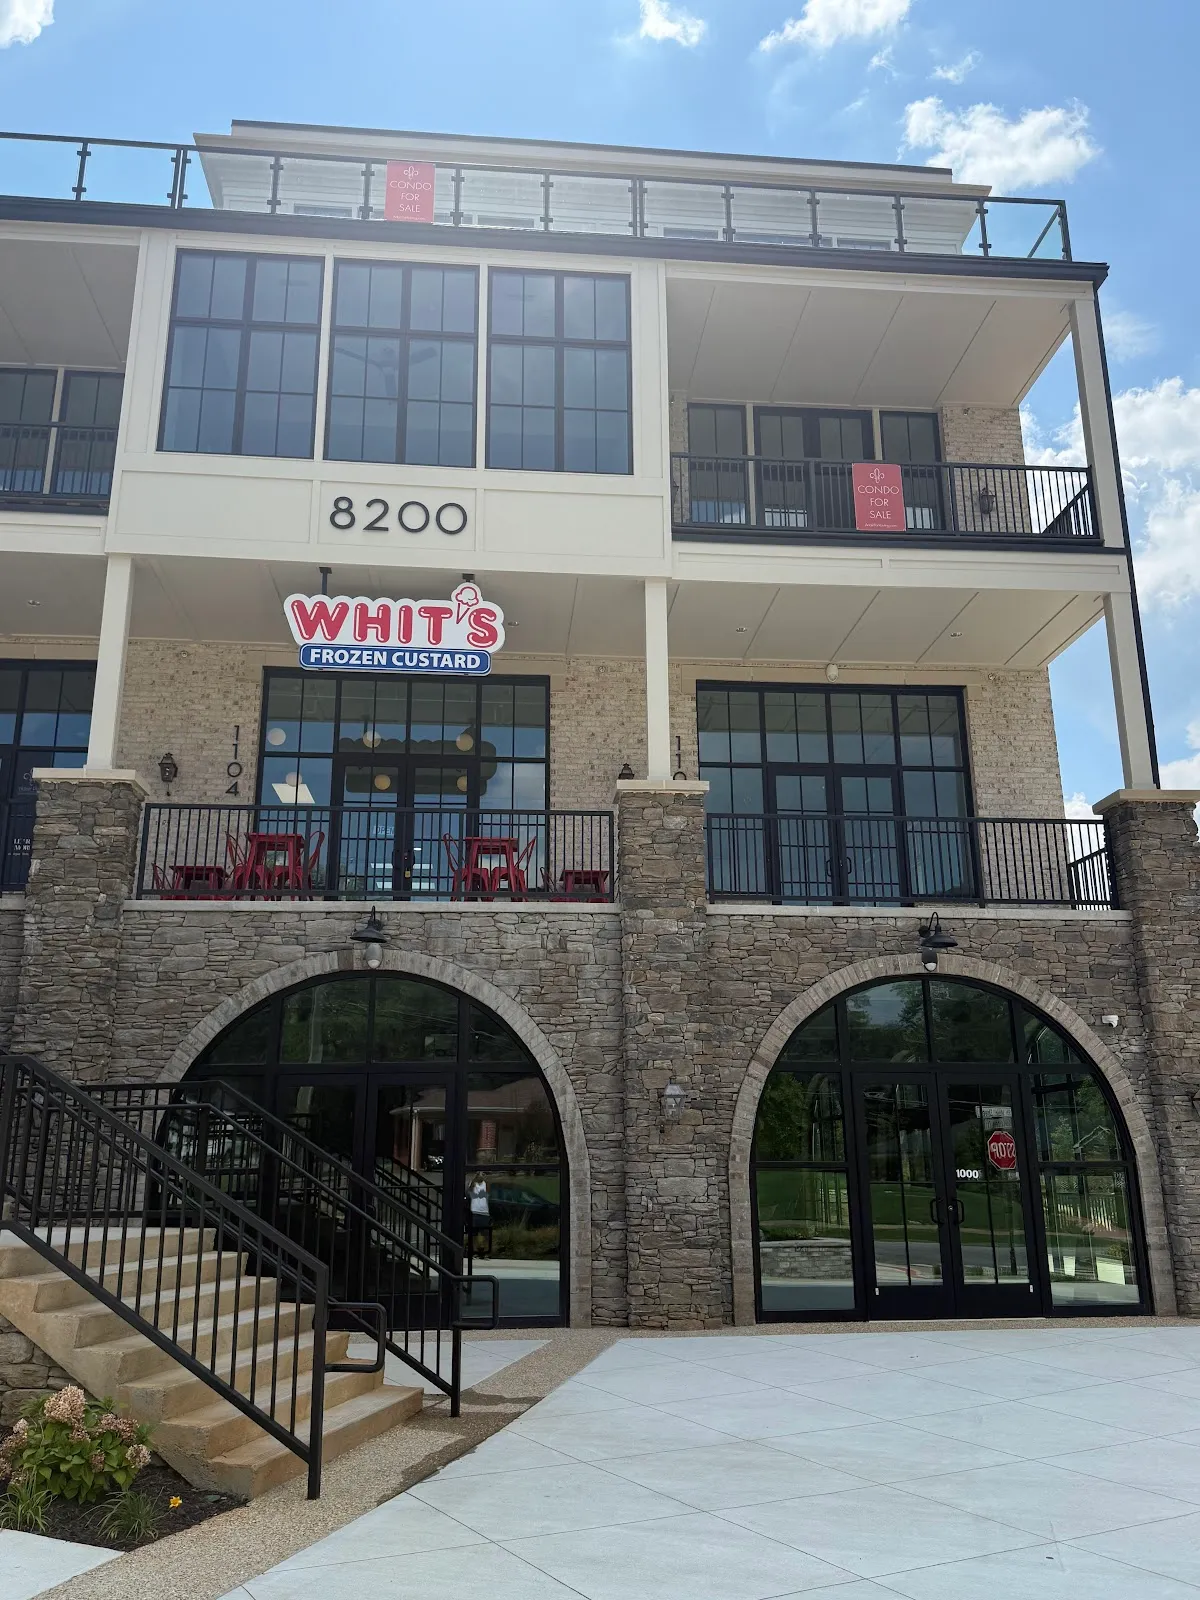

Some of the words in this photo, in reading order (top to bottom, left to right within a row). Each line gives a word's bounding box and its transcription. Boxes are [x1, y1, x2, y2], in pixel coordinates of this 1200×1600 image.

[389, 180, 432, 191] CONDO
[400, 192, 420, 201] FOR
[399, 203, 421, 213] SALE
[857, 484, 900, 495] CONDO
[870, 497, 889, 507] FOR
[329, 496, 468, 535] 8200
[869, 510, 892, 520] SALE
[290, 587, 499, 648] WHIT'S
[309, 648, 388, 666] FROZEN
[391, 652, 481, 669] CUSTARD
[225, 725, 243, 797] 1104
[955, 1168, 980, 1179] 1000
